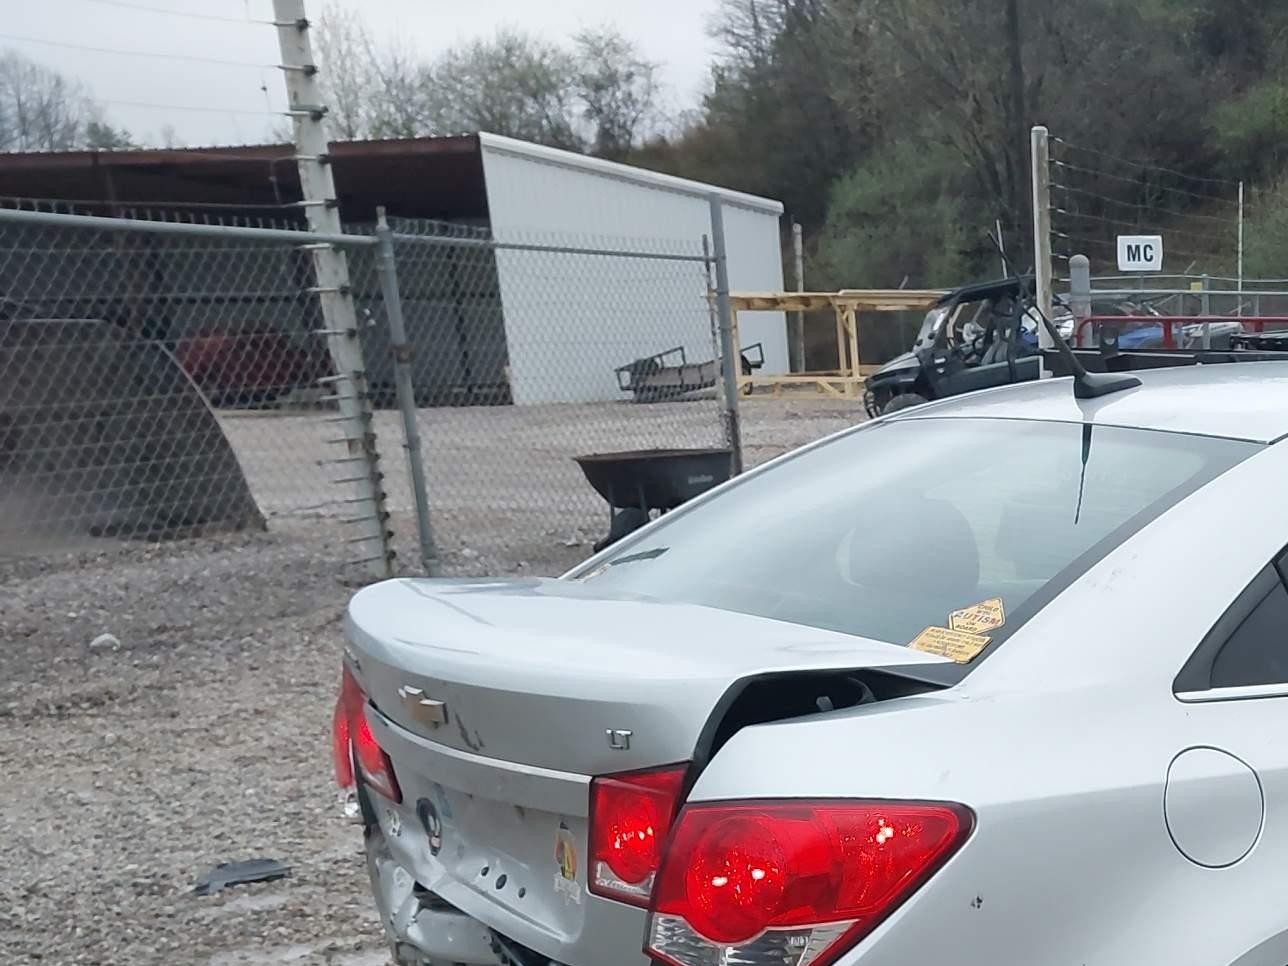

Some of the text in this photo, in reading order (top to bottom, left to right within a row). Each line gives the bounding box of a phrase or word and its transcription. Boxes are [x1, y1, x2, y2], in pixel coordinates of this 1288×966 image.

[1127, 244, 1153, 262] MC
[953, 611, 1001, 625] AUTISM
[606, 729, 632, 750] LT
